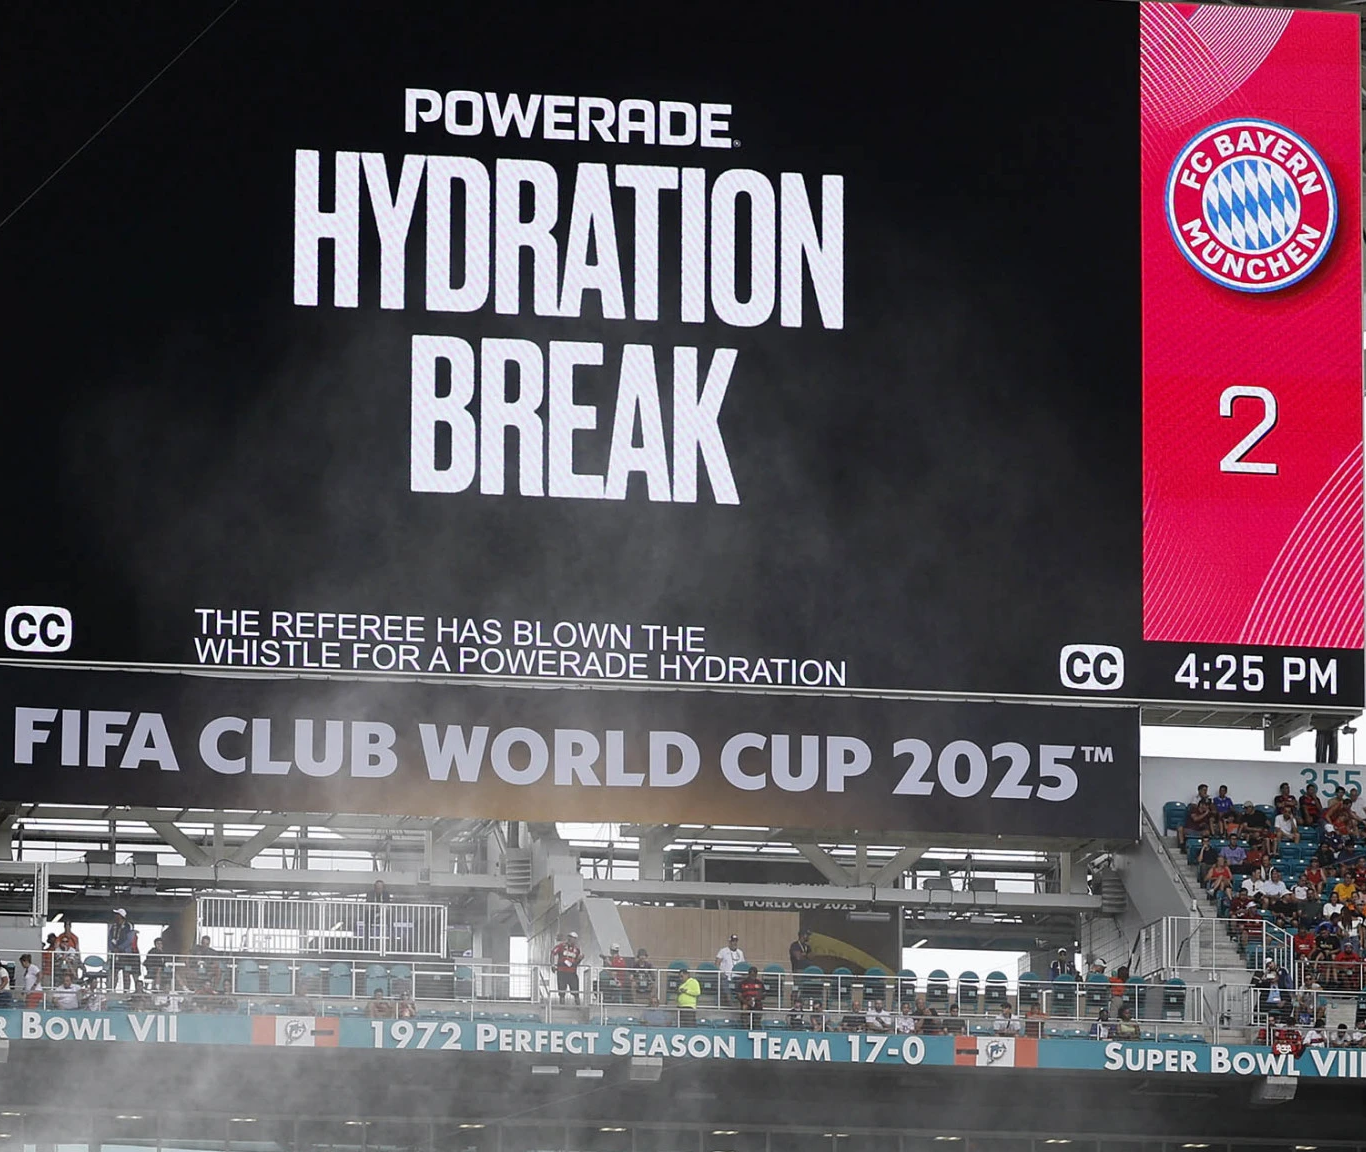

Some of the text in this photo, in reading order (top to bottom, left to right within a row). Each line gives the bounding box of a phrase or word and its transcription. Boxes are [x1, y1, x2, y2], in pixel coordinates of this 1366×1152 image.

[406, 89, 731, 148] POWERADE
[1180, 130, 1323, 197] FC BAYERN
[294, 150, 843, 329] HYDRATION
[1183, 220, 1321, 281] MÜNCHEN
[411, 335, 739, 504] BREAK
[1220, 386, 1276, 473] 2
[11, 612, 66, 647] CC
[195, 609, 705, 652] THE REFEREE HAS BLOWN THE
[195, 638, 853, 690] WHISTLE FOR A POWERADE HYDRATION
[1065, 650, 1120, 685] CC
[1175, 654, 1336, 694] 4:25 PM
[15, 707, 179, 771] FIFA
[200, 717, 397, 780] CLUB
[419, 724, 700, 786] WORLD
[721, 733, 871, 792] CUP
[1300, 768, 1362, 799] 355
[22, 1011, 116, 1041] BOWL
[129, 1014, 177, 1042] VII
[371, 1022, 925, 1065] 1972 PERFECT SEASON TEAM 17-0
[1104, 1042, 1197, 1072] SUPER
[1210, 1046, 1300, 1076] BOWL
